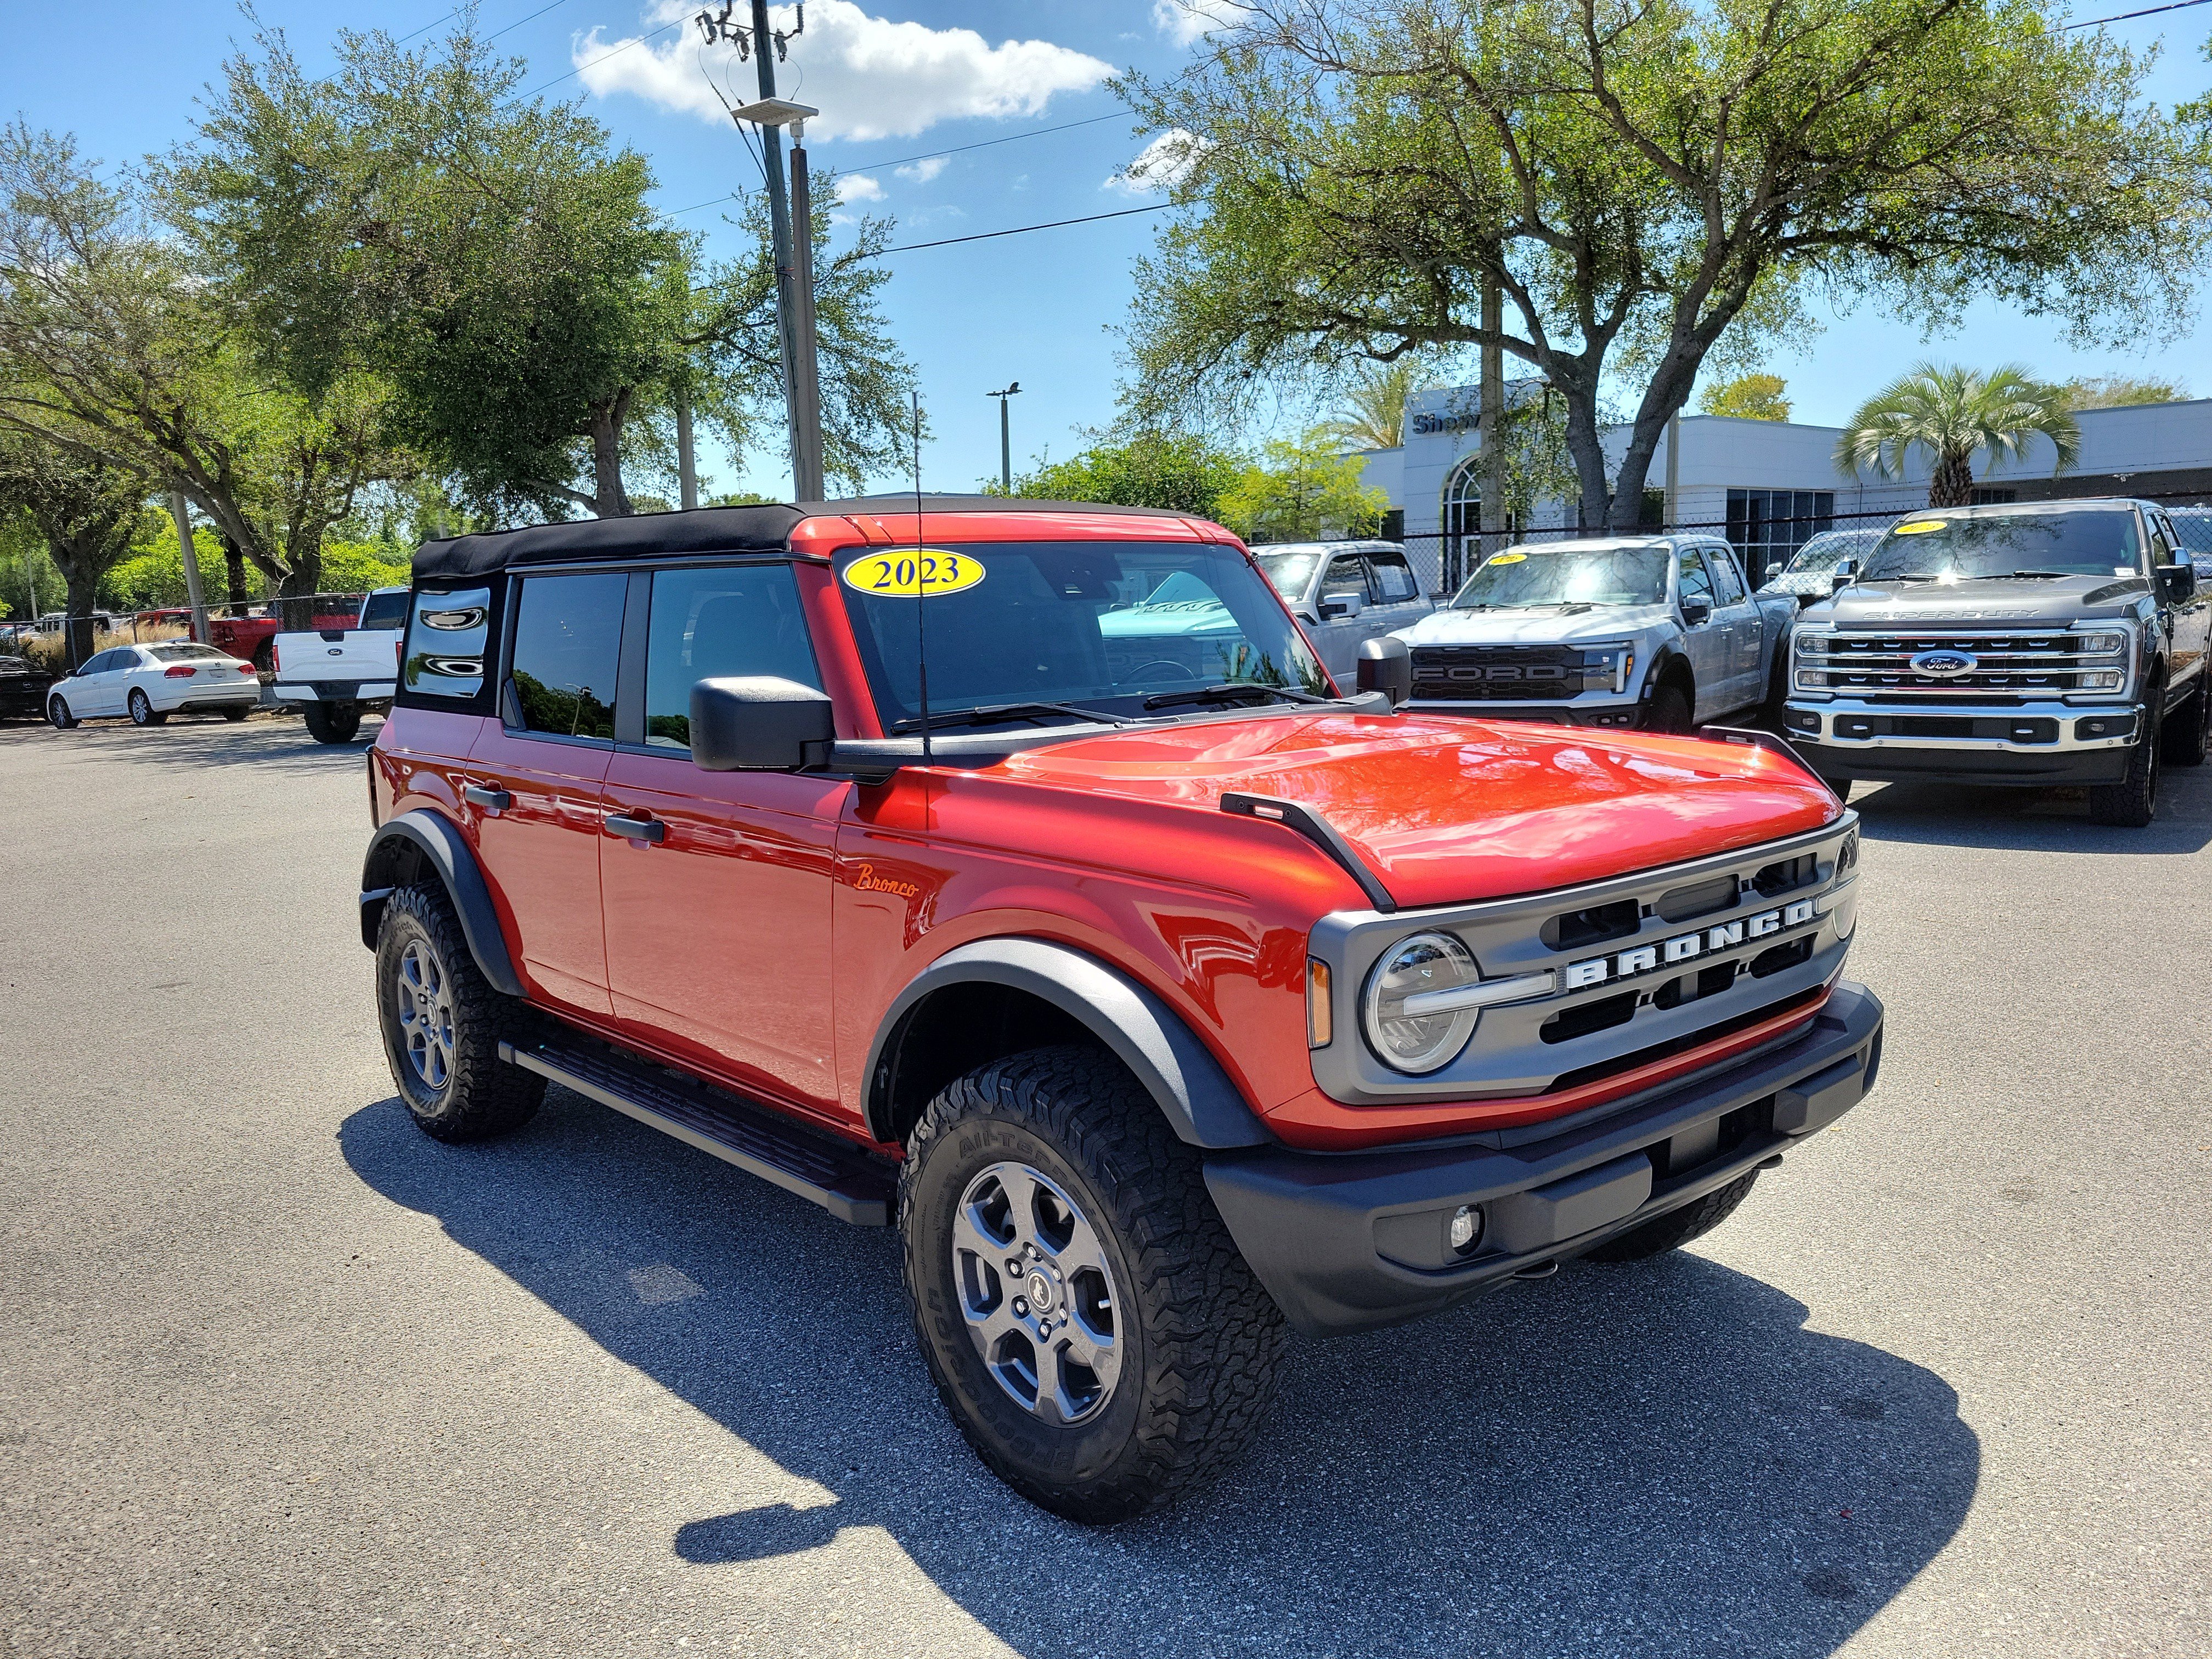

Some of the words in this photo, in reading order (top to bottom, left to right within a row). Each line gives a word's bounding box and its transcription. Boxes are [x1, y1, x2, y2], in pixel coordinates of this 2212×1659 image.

[872, 557, 959, 589] 2023
[1863, 611, 1956, 620] SUPER
[1961, 609, 2040, 618] DUTY
[1412, 665, 1568, 681] FORD
[853, 863, 920, 898] Bronco
[1565, 898, 1813, 989] BRONCO
